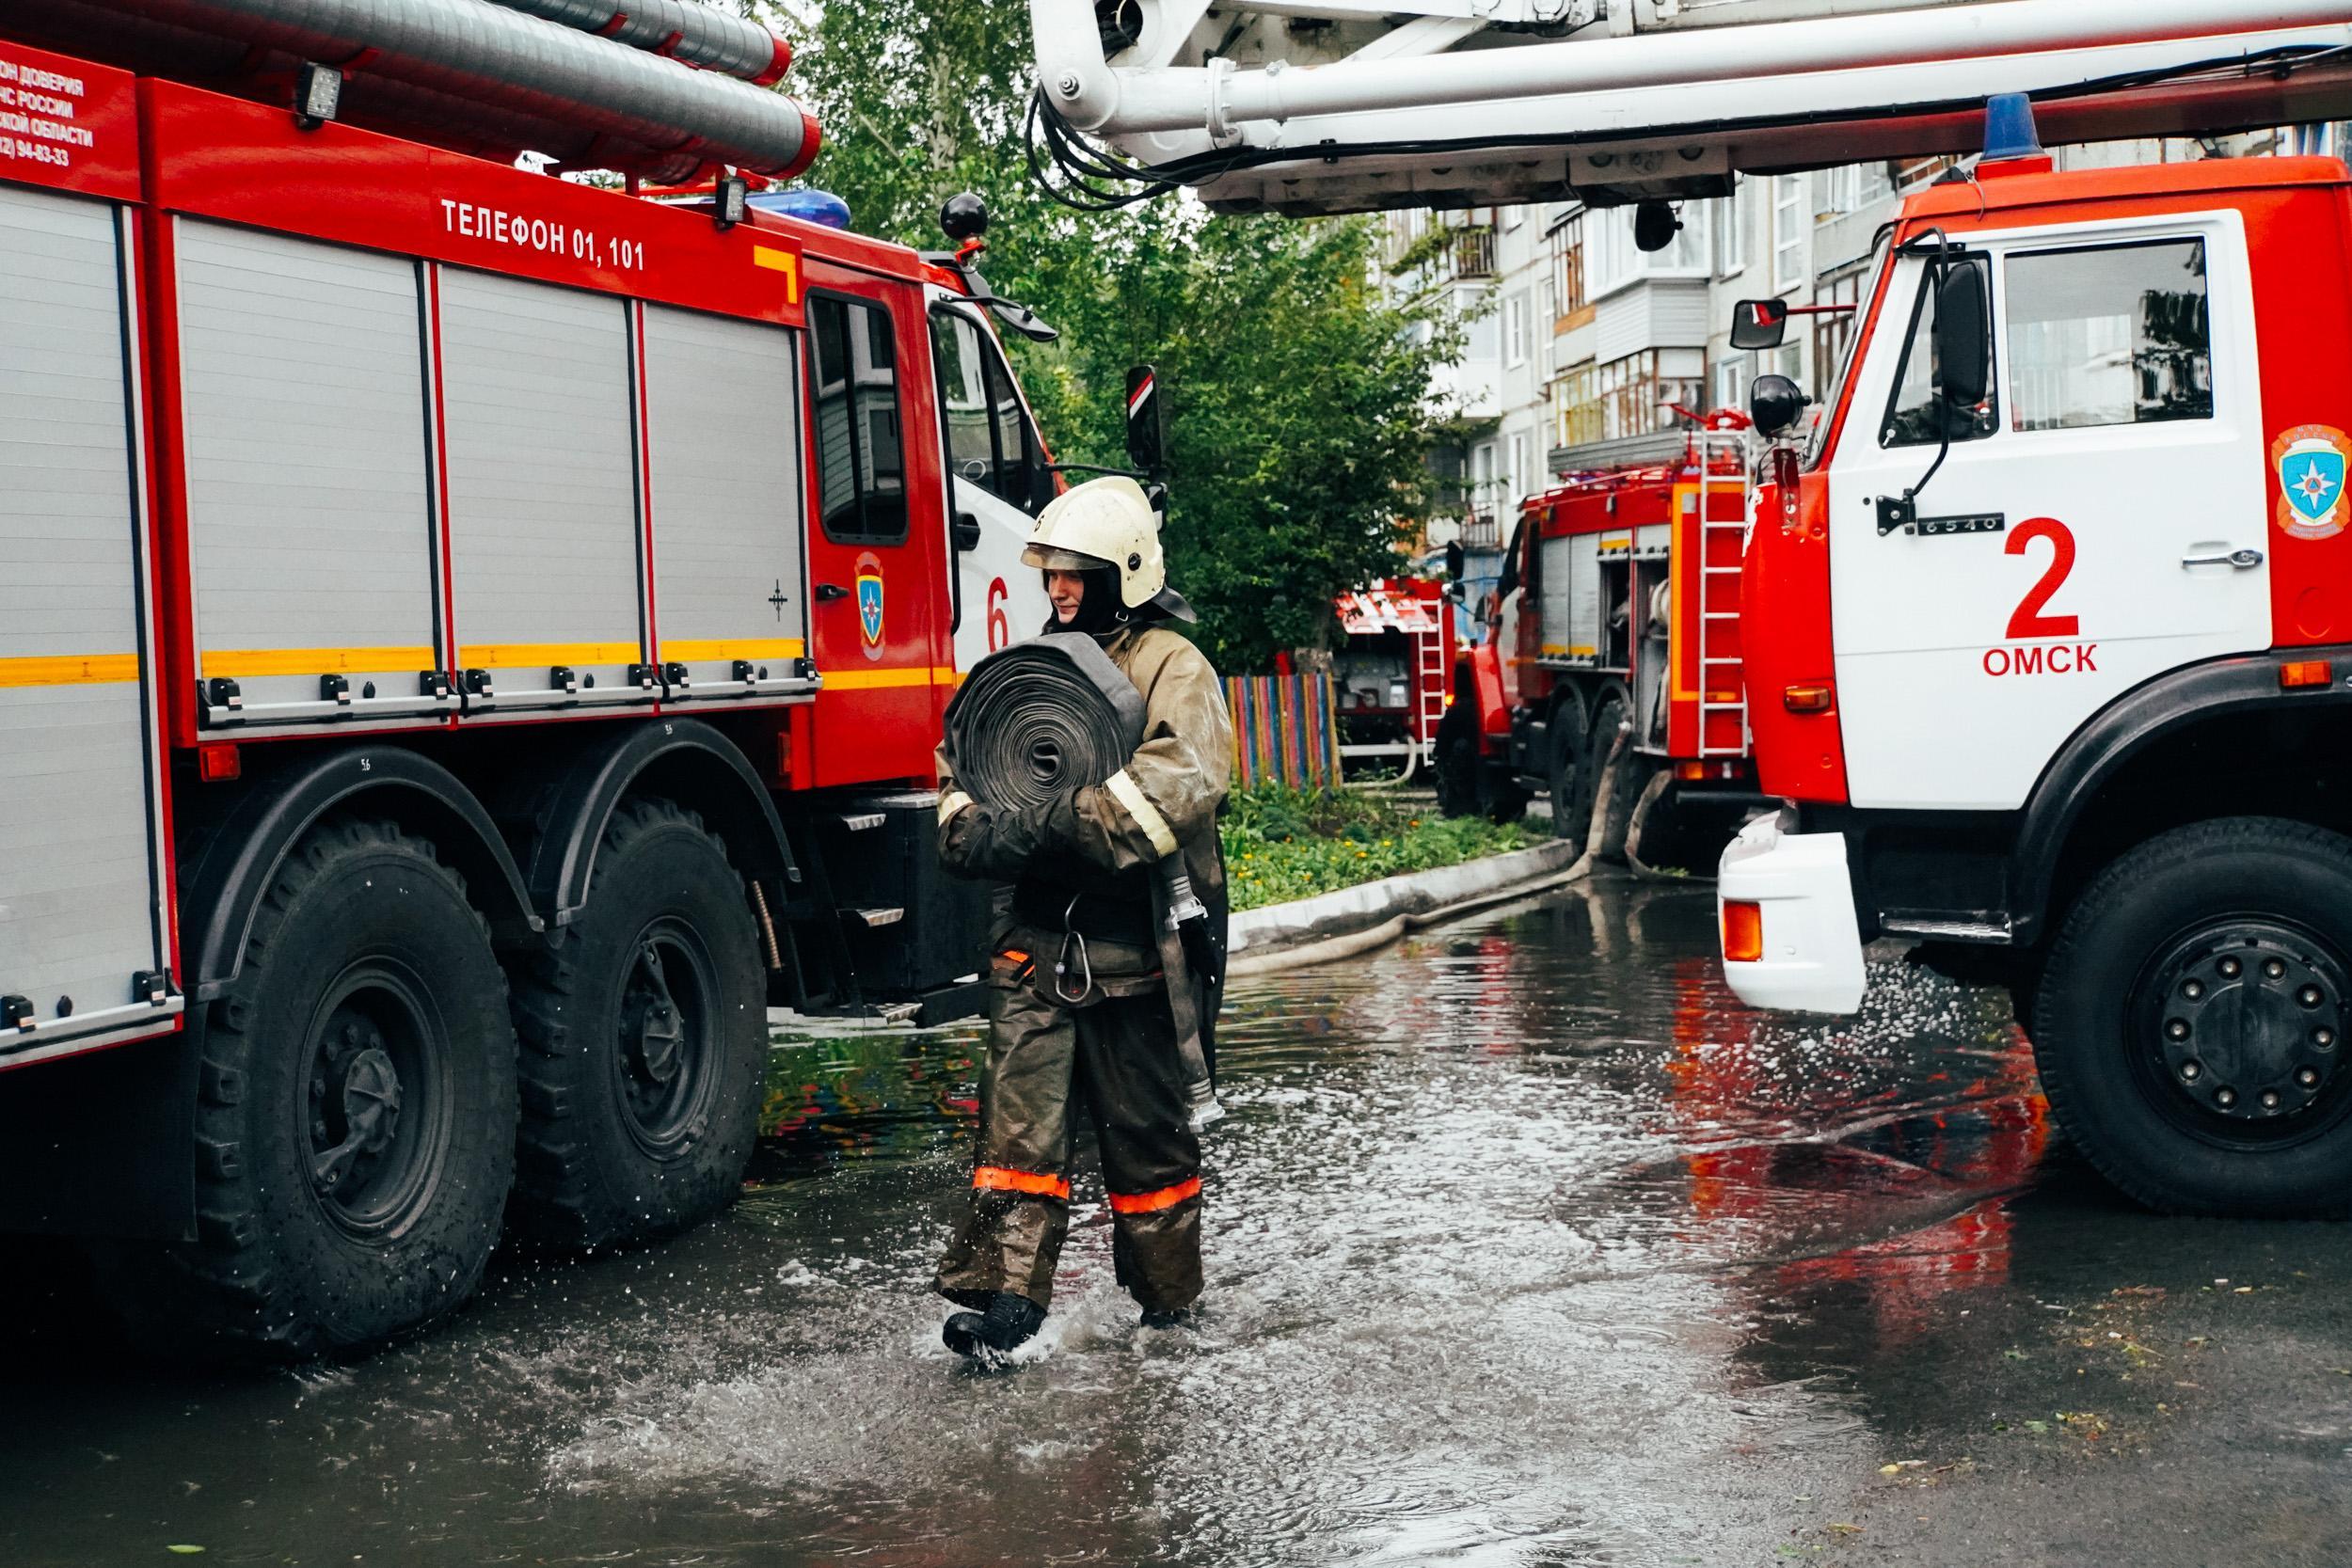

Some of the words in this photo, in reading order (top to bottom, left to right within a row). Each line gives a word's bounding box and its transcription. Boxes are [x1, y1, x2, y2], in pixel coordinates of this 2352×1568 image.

[19, 65, 84, 97] ДОВЕРИЯ
[17, 89, 73, 119] РОССИИ
[30, 118, 93, 148] ОБЛАСТИ
[16, 139, 69, 166] 94-83-33
[441, 198, 564, 255] ТЕЛЕФОН
[572, 229, 602, 268] 01,
[609, 237, 644, 271] 101
[1926, 518, 1996, 533] 6540
[2004, 517, 2079, 640] 2
[987, 577, 1009, 654] 6
[1982, 644, 2097, 676] ОМСК
